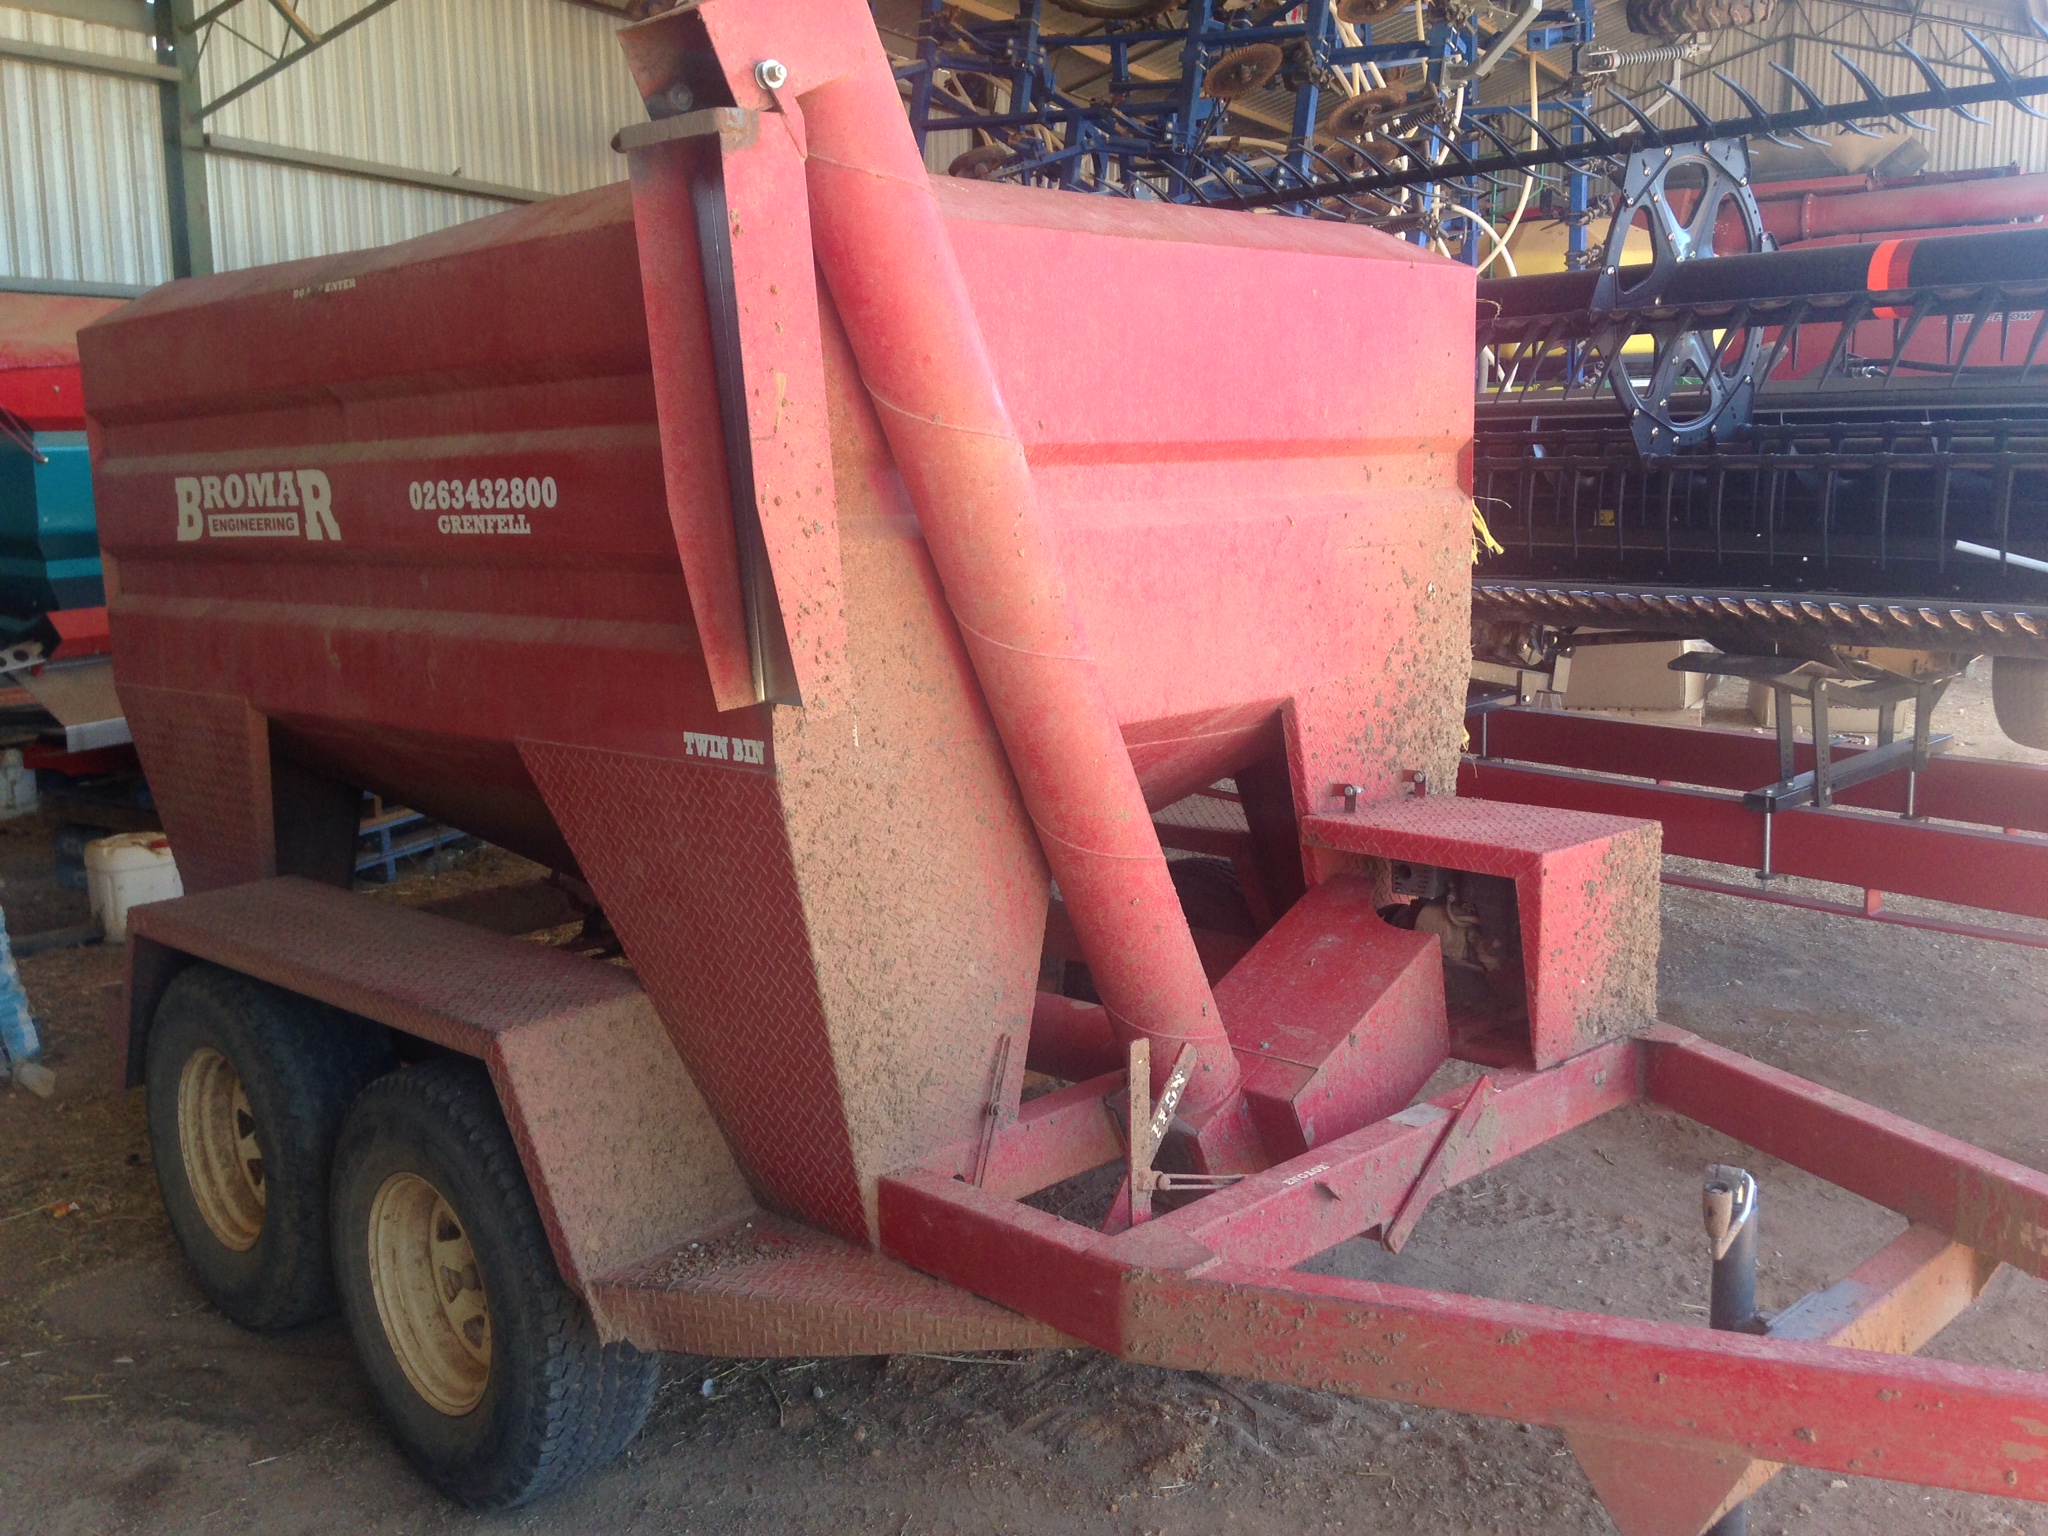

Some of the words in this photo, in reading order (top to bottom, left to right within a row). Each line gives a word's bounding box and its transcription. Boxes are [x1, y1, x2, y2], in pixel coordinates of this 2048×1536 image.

[174, 469, 342, 541] BROMAR
[409, 476, 557, 510] 0263432800
[212, 517, 295, 532] ENGINEERING
[438, 514, 531, 534] GRENFELL
[683, 731, 728, 760] TWIN
[731, 737, 765, 765] BIN
